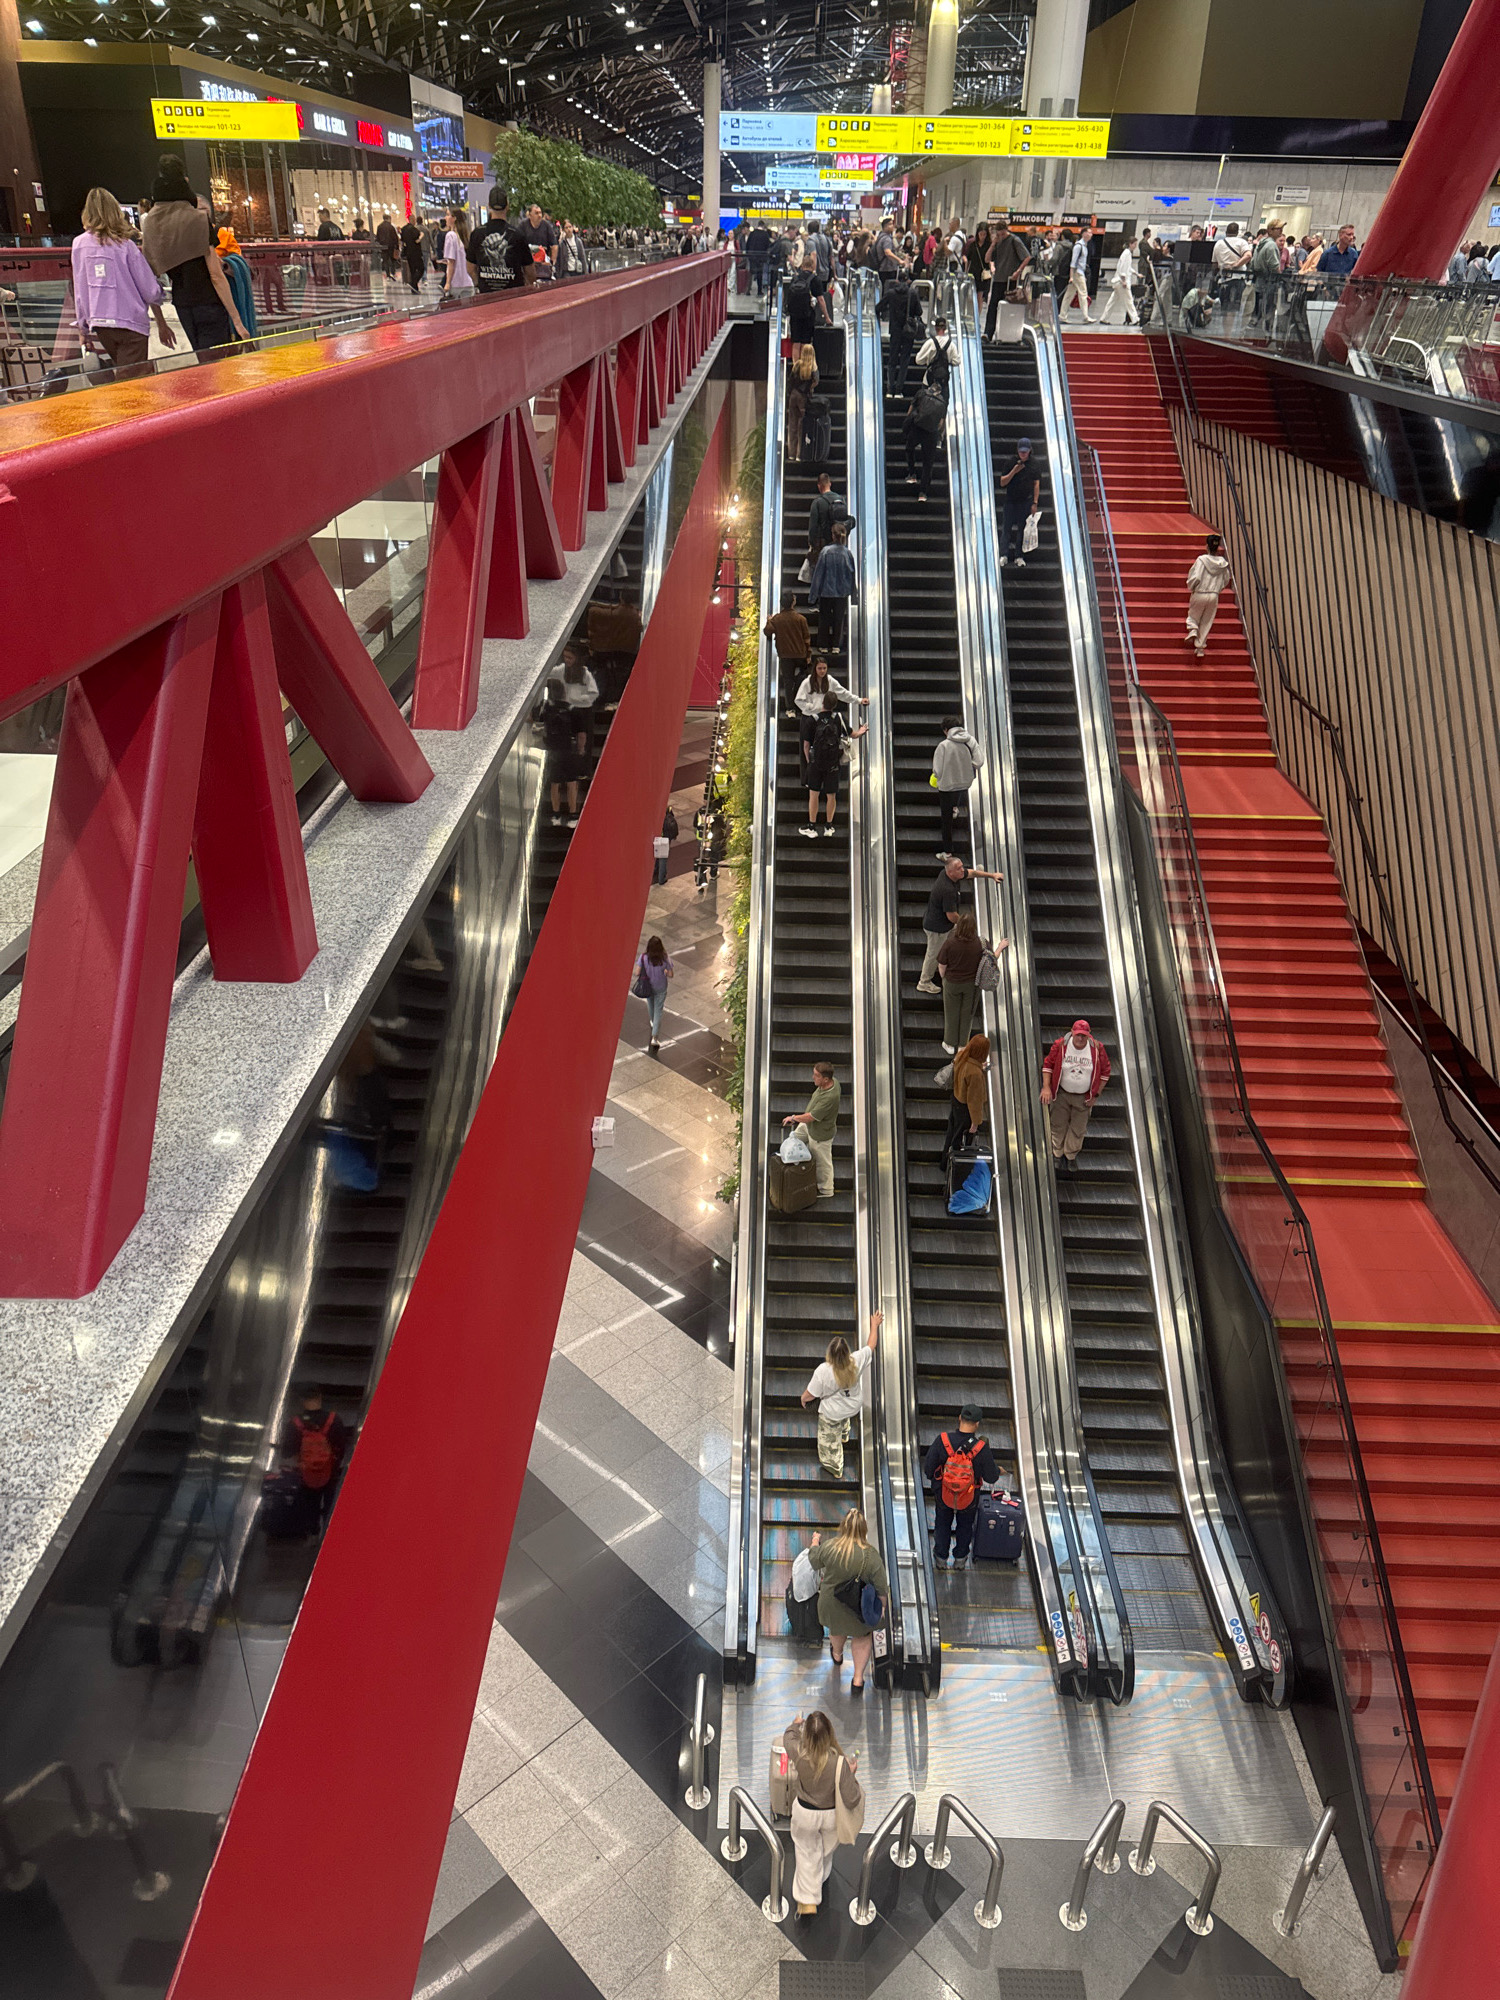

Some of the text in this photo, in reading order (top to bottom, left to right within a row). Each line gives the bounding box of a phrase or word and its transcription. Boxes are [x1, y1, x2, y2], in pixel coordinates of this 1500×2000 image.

[217, 123, 241, 131] 101-123
[979, 122, 1005, 130] 301-364
[977, 141, 1001, 149] 101-123
[1075, 142, 1102, 150] 431-438
